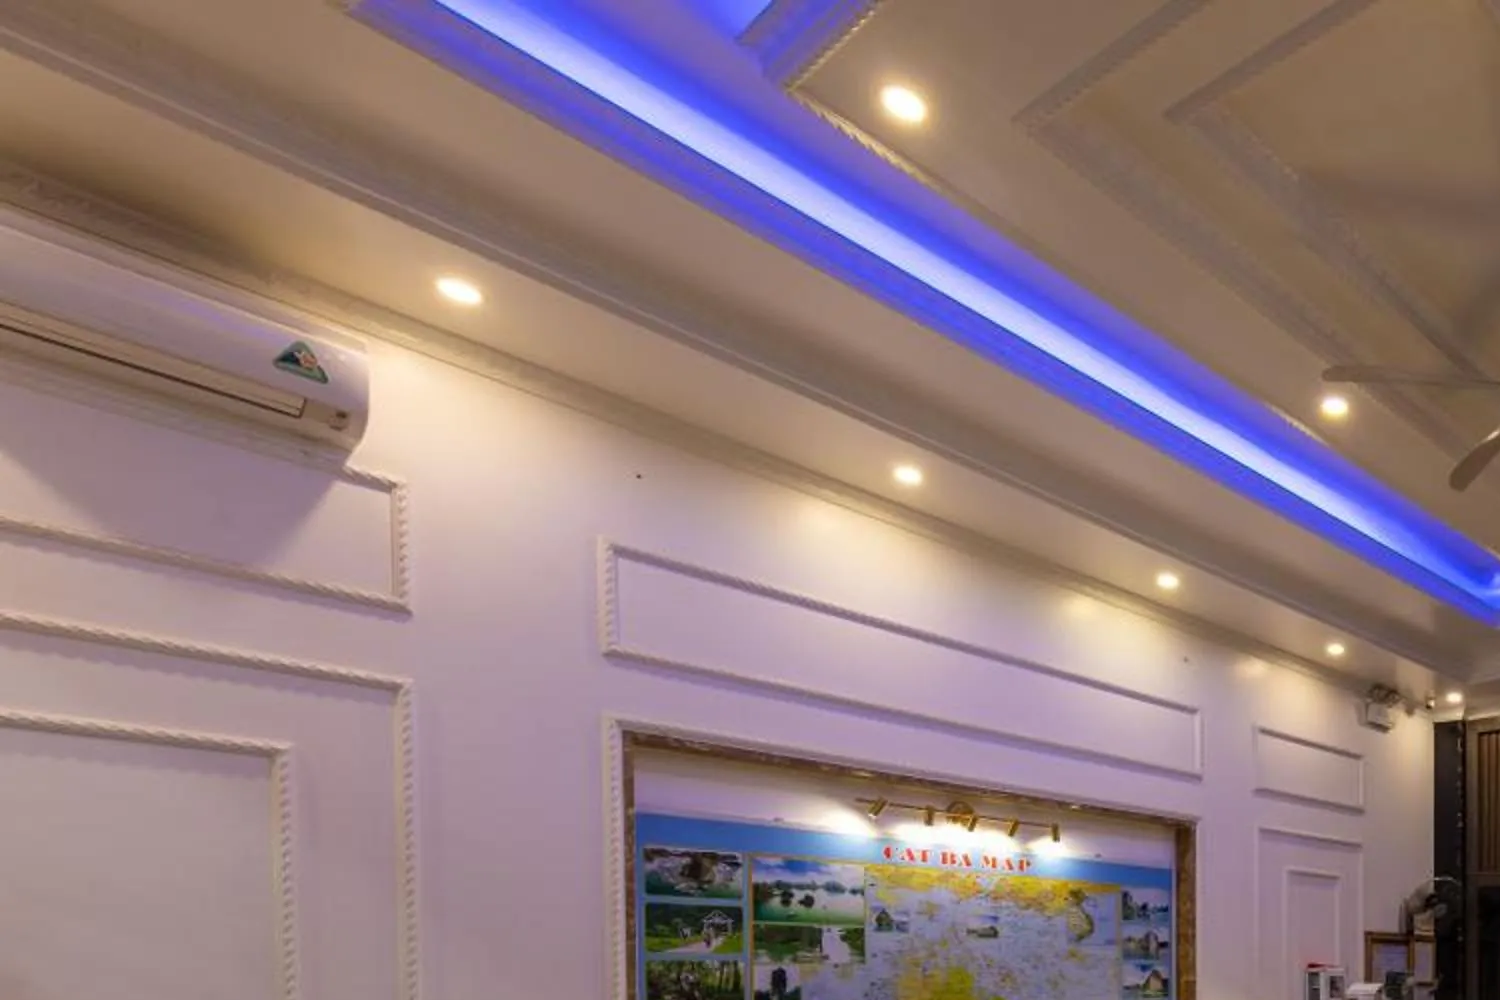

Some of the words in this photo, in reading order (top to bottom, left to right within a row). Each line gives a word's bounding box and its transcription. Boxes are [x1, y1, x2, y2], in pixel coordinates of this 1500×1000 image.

[882, 845, 930, 863] CAT
[939, 850, 972, 868] BA
[982, 854, 1031, 873] MAP
